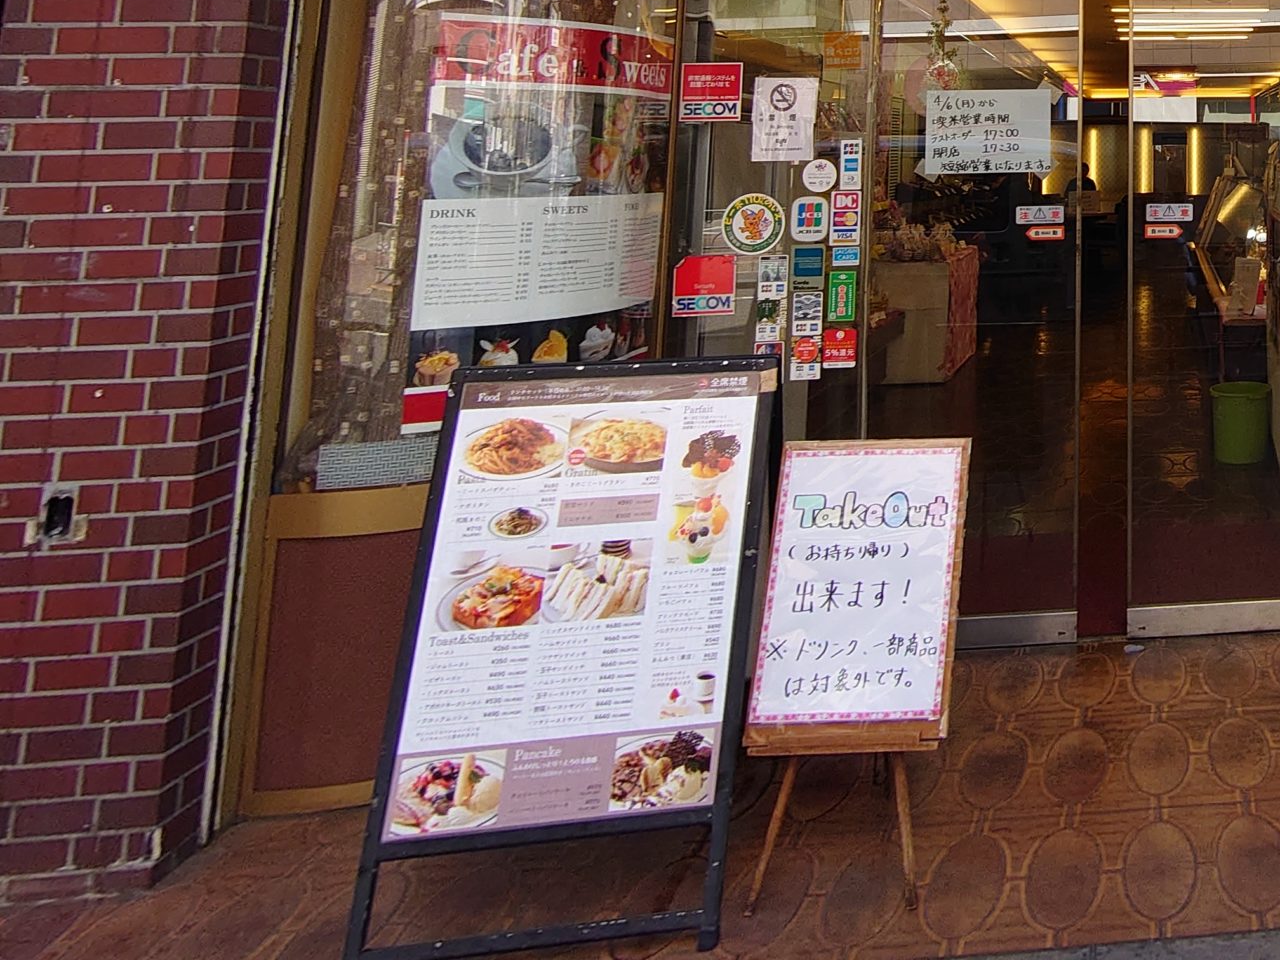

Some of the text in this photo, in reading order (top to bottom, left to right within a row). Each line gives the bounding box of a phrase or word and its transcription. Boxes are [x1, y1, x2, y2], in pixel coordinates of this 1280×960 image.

[599, 35, 667, 88] Sweets
[683, 102, 737, 116] SECOM
[983, 128, 1019, 141] 17:00
[981, 143, 1020, 153] 17:30
[835, 194, 857, 208] DC
[430, 208, 477, 219] DRINK
[543, 205, 589, 215] SWEETS
[676, 296, 731, 311] SECOM
[824, 348, 855, 357] 5%還元
[710, 376, 749, 386] 全席禁煙
[477, 392, 501, 402] Food
[683, 405, 713, 414] Parfait
[793, 491, 949, 530] TakeOut
[429, 630, 529, 647] Toast&Sandwiches
[514, 746, 562, 761] Pancake
